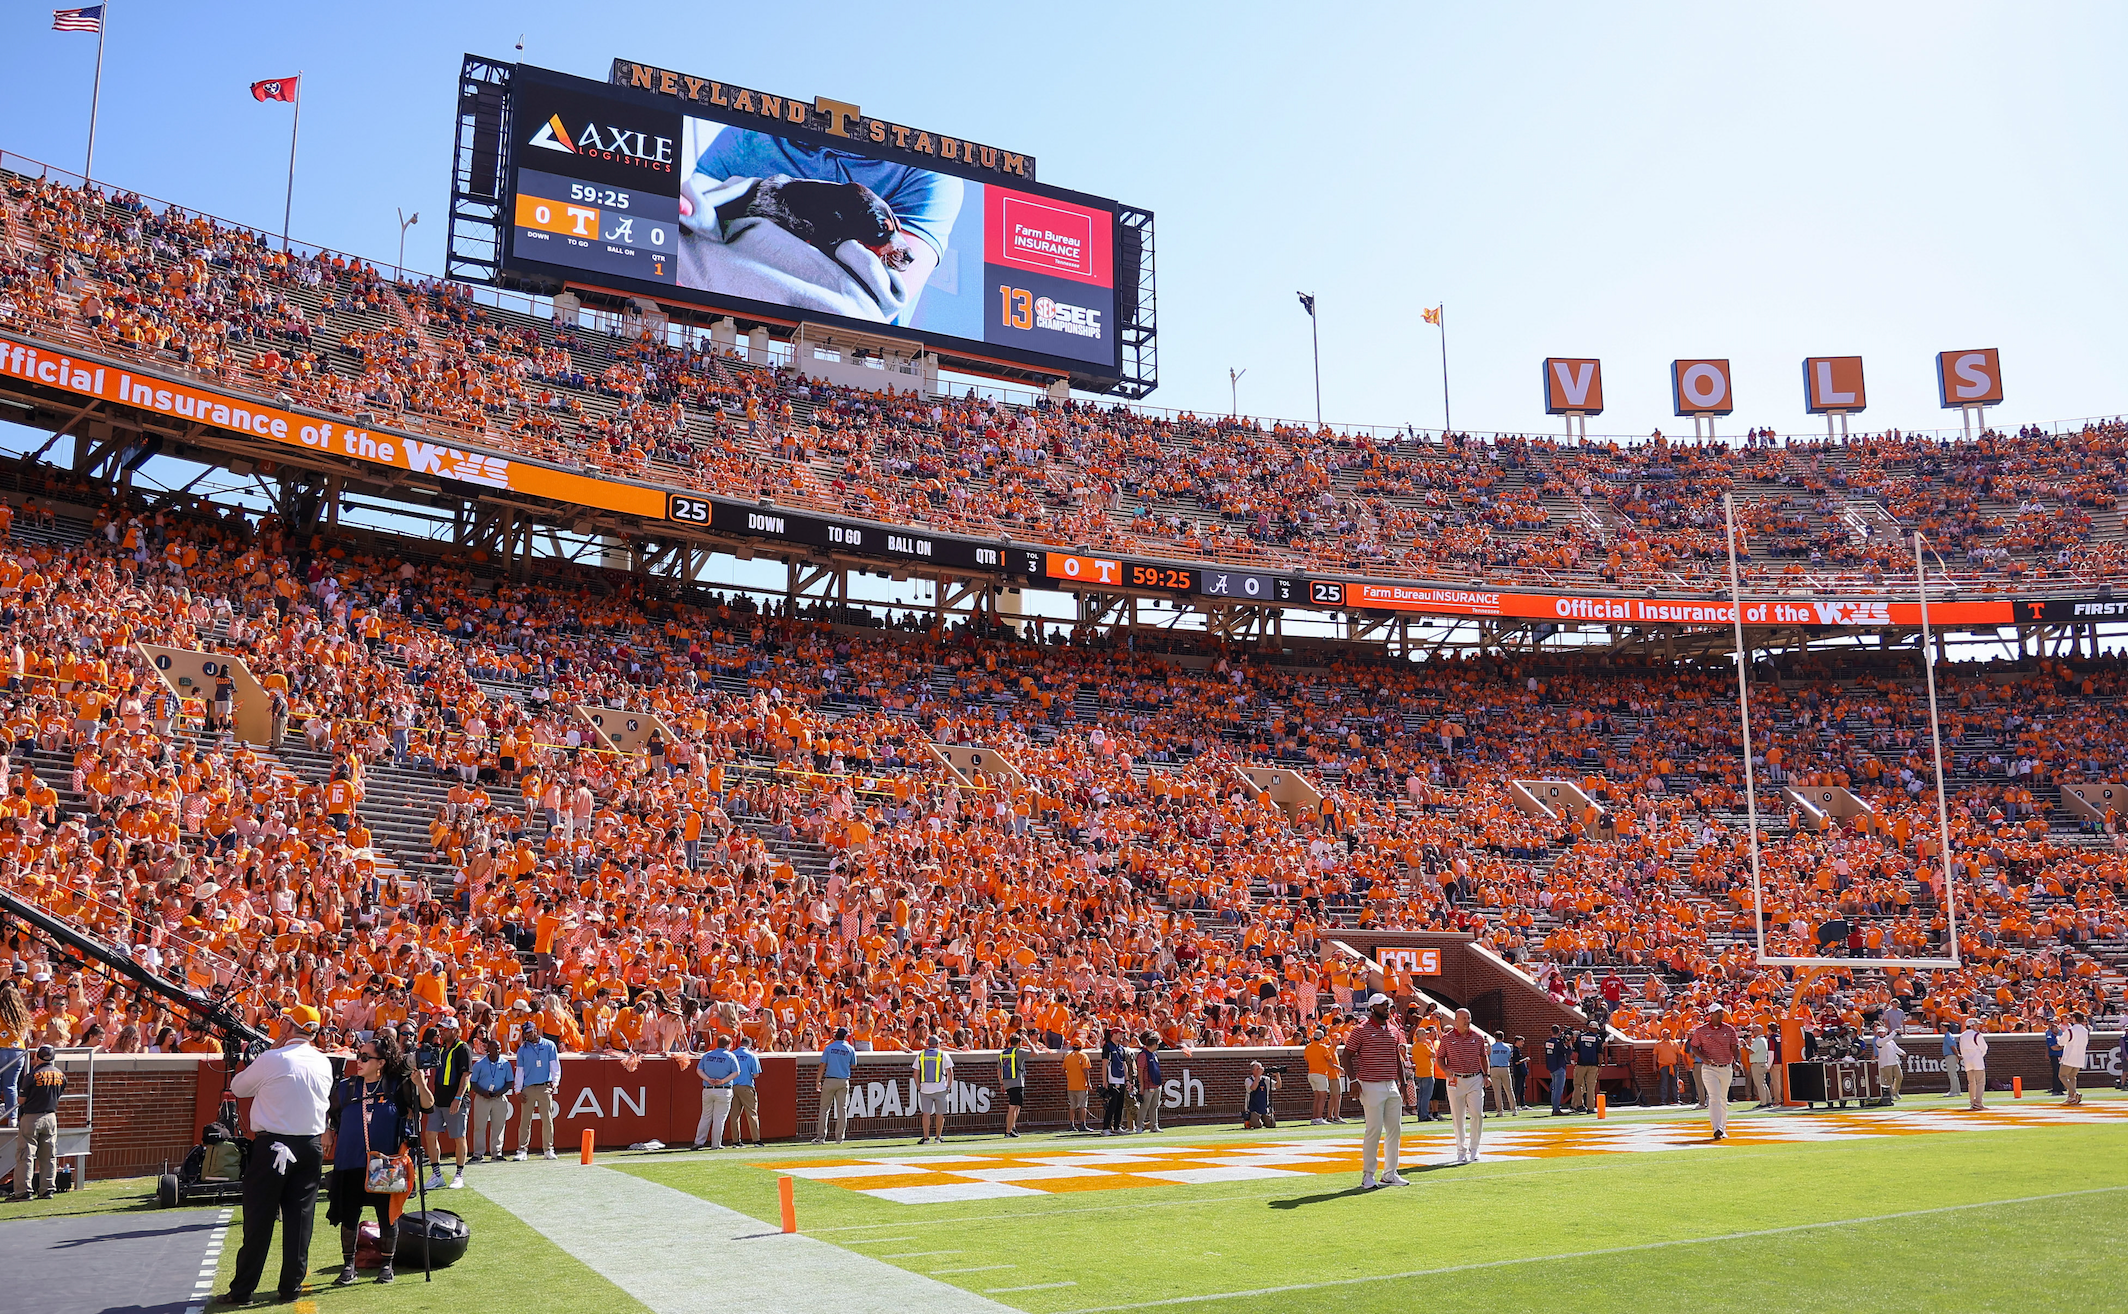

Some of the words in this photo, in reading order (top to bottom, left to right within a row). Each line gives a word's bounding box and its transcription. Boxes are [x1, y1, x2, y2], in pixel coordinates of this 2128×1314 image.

[631, 63, 806, 124] NEYLAND
[815, 96, 860, 138] T
[870, 121, 1025, 175] STADIUM
[578, 122, 673, 164] AXLE
[578, 147, 671, 172] LOGISTICS
[570, 183, 630, 209] 59:25
[535, 206, 551, 224] 0
[567, 207, 595, 235] T
[650, 228, 665, 245] 0
[1015, 224, 1042, 239] Farm
[1044, 230, 1081, 247] Bureau
[527, 231, 550, 241] DOWN
[567, 238, 578, 246] TO
[607, 245, 624, 255] BALL
[651, 254, 666, 262] QTR
[1014, 235, 1080, 259] INSURANCE
[654, 263, 664, 275] 1
[1055, 258, 1080, 268] Tennessee
[1000, 284, 1033, 331] 13
[1055, 302, 1101, 328] SEC
[1036, 316, 1101, 339] CHAMPIONSHIPS
[1553, 362, 1595, 405] V
[1682, 363, 1726, 407] O
[1816, 361, 1856, 404] L
[1954, 353, 1991, 398] S
[119, 375, 289, 438] Insurance
[300, 423, 333, 448] of
[344, 429, 394, 462] the
[675, 500, 707, 521] 25
[748, 513, 785, 534] DOWN
[827, 526, 843, 543] TO
[844, 527, 862, 546] GO
[887, 535, 915, 555] BALL
[916, 539, 932, 556] ON
[975, 548, 997, 565] QTR
[1000, 550, 1006, 567] 1
[1026, 552, 1039, 560] TOL
[1064, 558, 1079, 576] 0
[1094, 560, 1115, 583] T
[1133, 566, 1191, 589] 59:25
[1245, 577, 1260, 595] 0
[1315, 584, 1340, 601] 25
[1028, 560, 1037, 572] 3
[1281, 587, 1290, 599] 3
[1364, 586, 1391, 598] Farm
[1394, 588, 1431, 601] Bureau
[1432, 591, 1499, 604] INSURANCE
[1555, 599, 1631, 619] Official
[1638, 601, 1735, 622] Insurance
[1747, 603, 1771, 622] of
[1774, 604, 1810, 622] the
[2027, 602, 2045, 619] T
[207, 664, 215, 675] J
[628, 721, 636, 730] K
[973, 756, 979, 764] L
[332, 788, 345, 803] 16
[1551, 787, 1558, 796] N
[2104, 790, 2111, 798] P
[781, 1007, 796, 1023] 16
[509, 1024, 520, 1042] 16
[833, 1078, 903, 1119] APA
